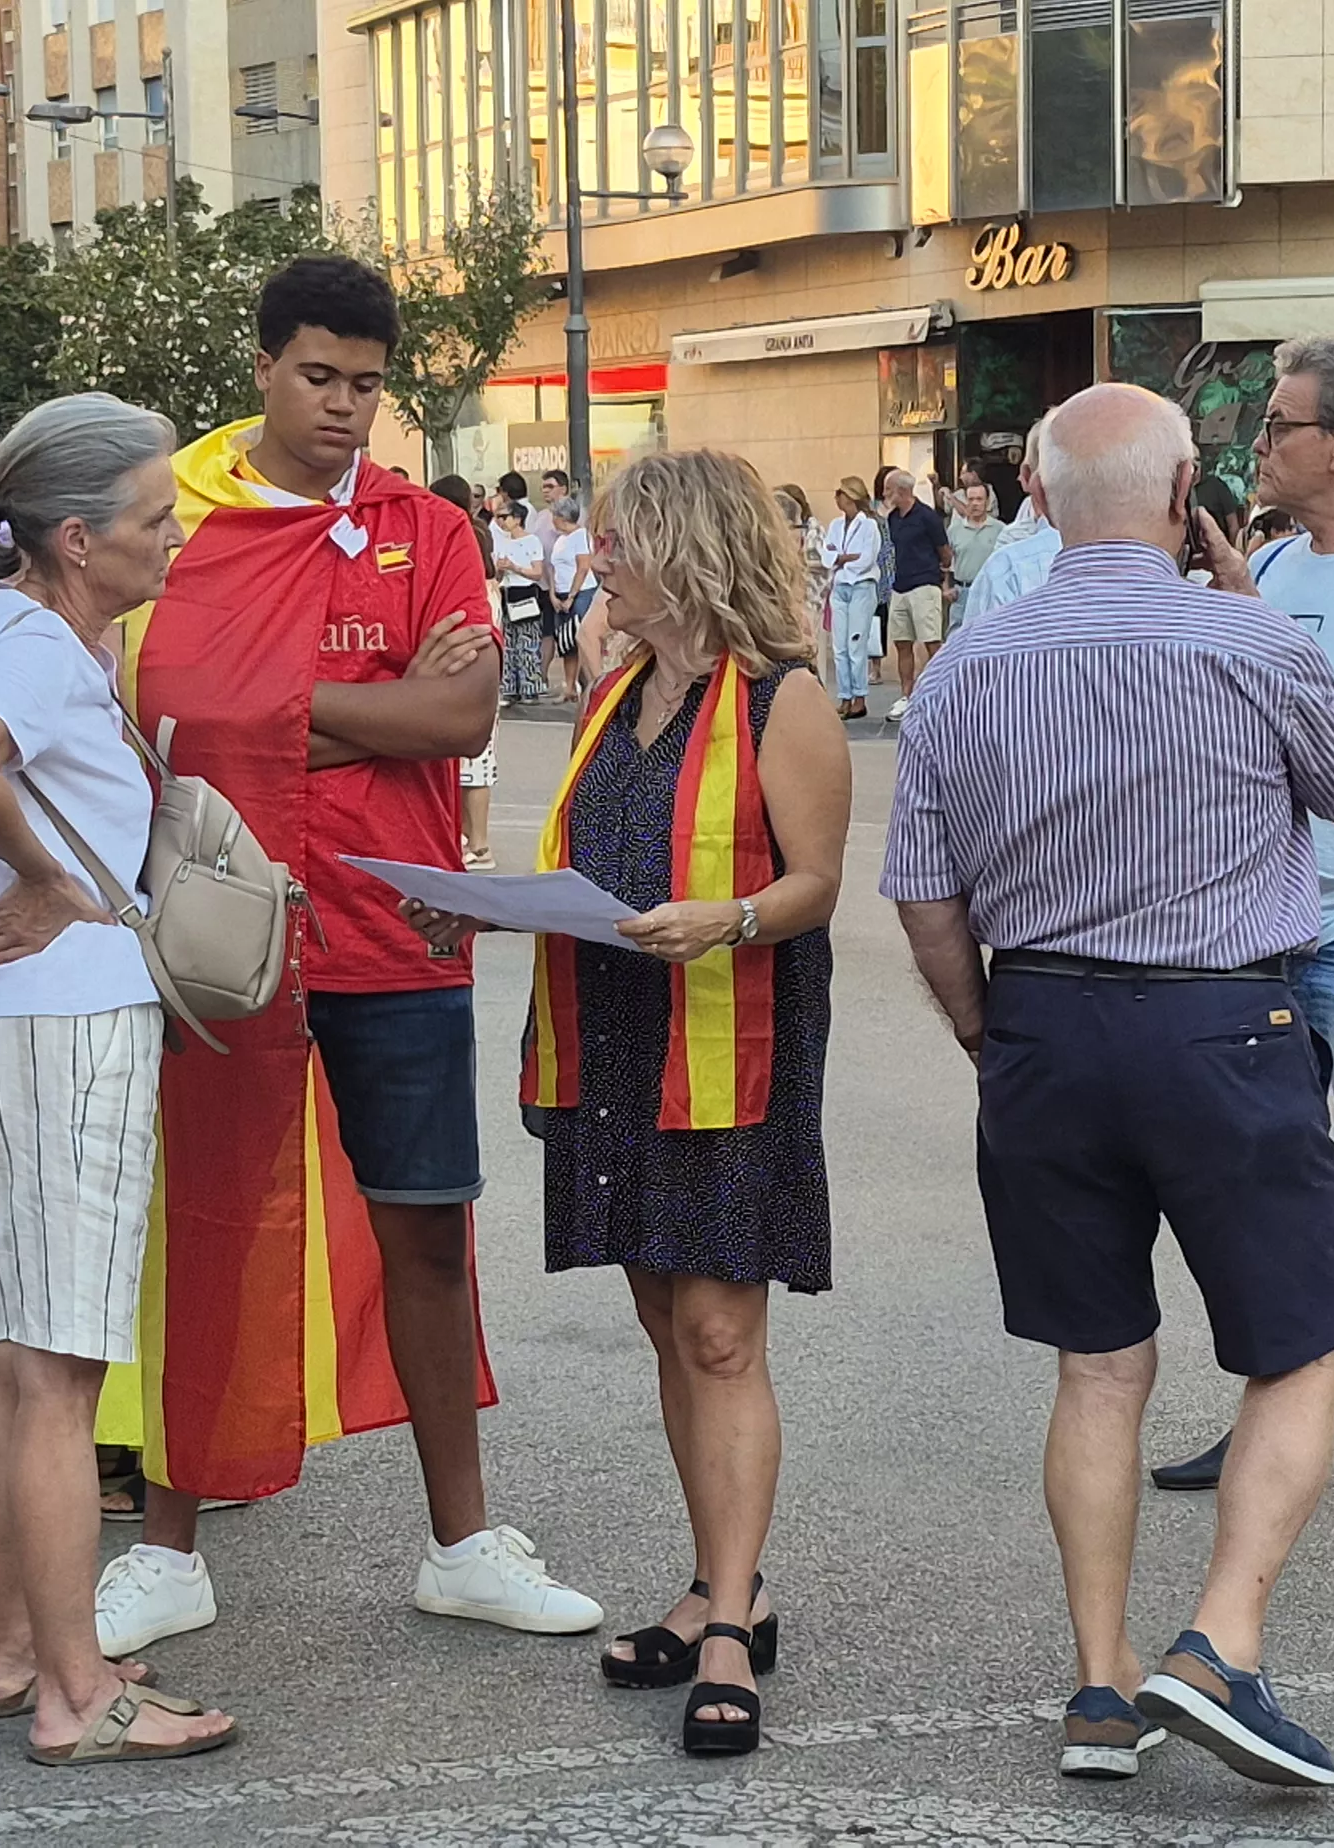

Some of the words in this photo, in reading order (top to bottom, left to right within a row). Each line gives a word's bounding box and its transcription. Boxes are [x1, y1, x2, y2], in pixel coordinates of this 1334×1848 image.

[964, 222, 1071, 292] Bar
[513, 444, 567, 473] CERRADO
[318, 614, 391, 652] aña
